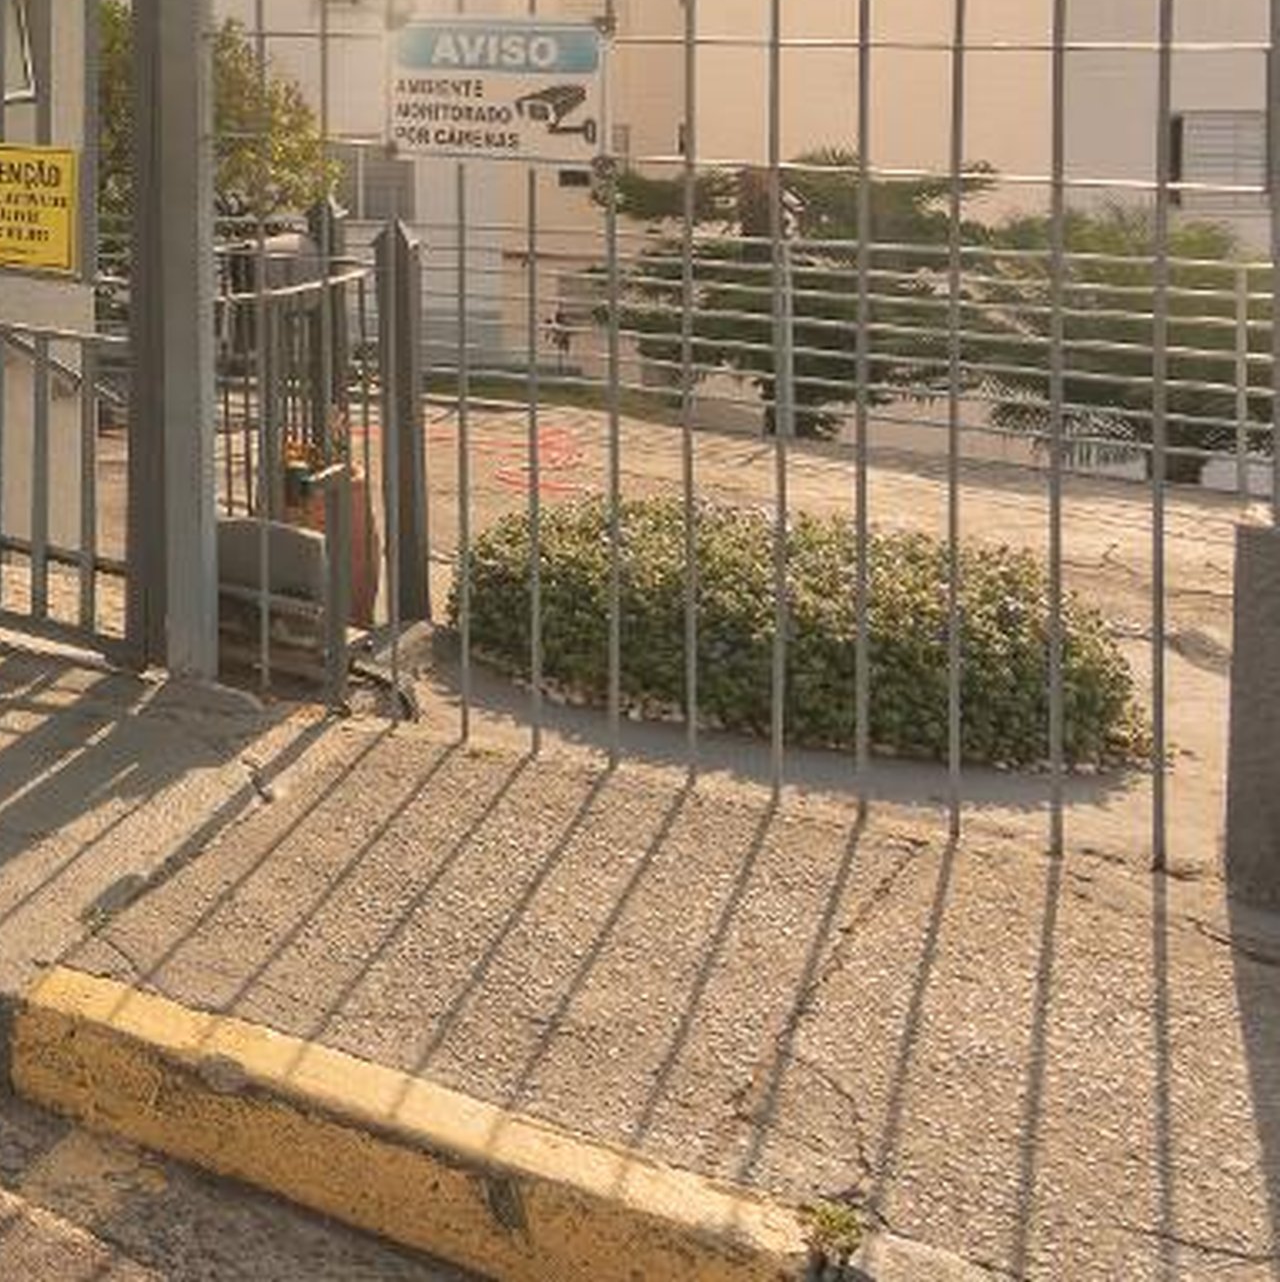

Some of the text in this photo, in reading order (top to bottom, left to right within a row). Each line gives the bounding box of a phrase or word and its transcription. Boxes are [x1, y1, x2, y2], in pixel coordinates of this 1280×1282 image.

[430, 34, 559, 67] AVISO
[395, 78, 484, 98] AMBIENTE
[395, 102, 513, 124] MONITORADO
[395, 126, 430, 145] POR
